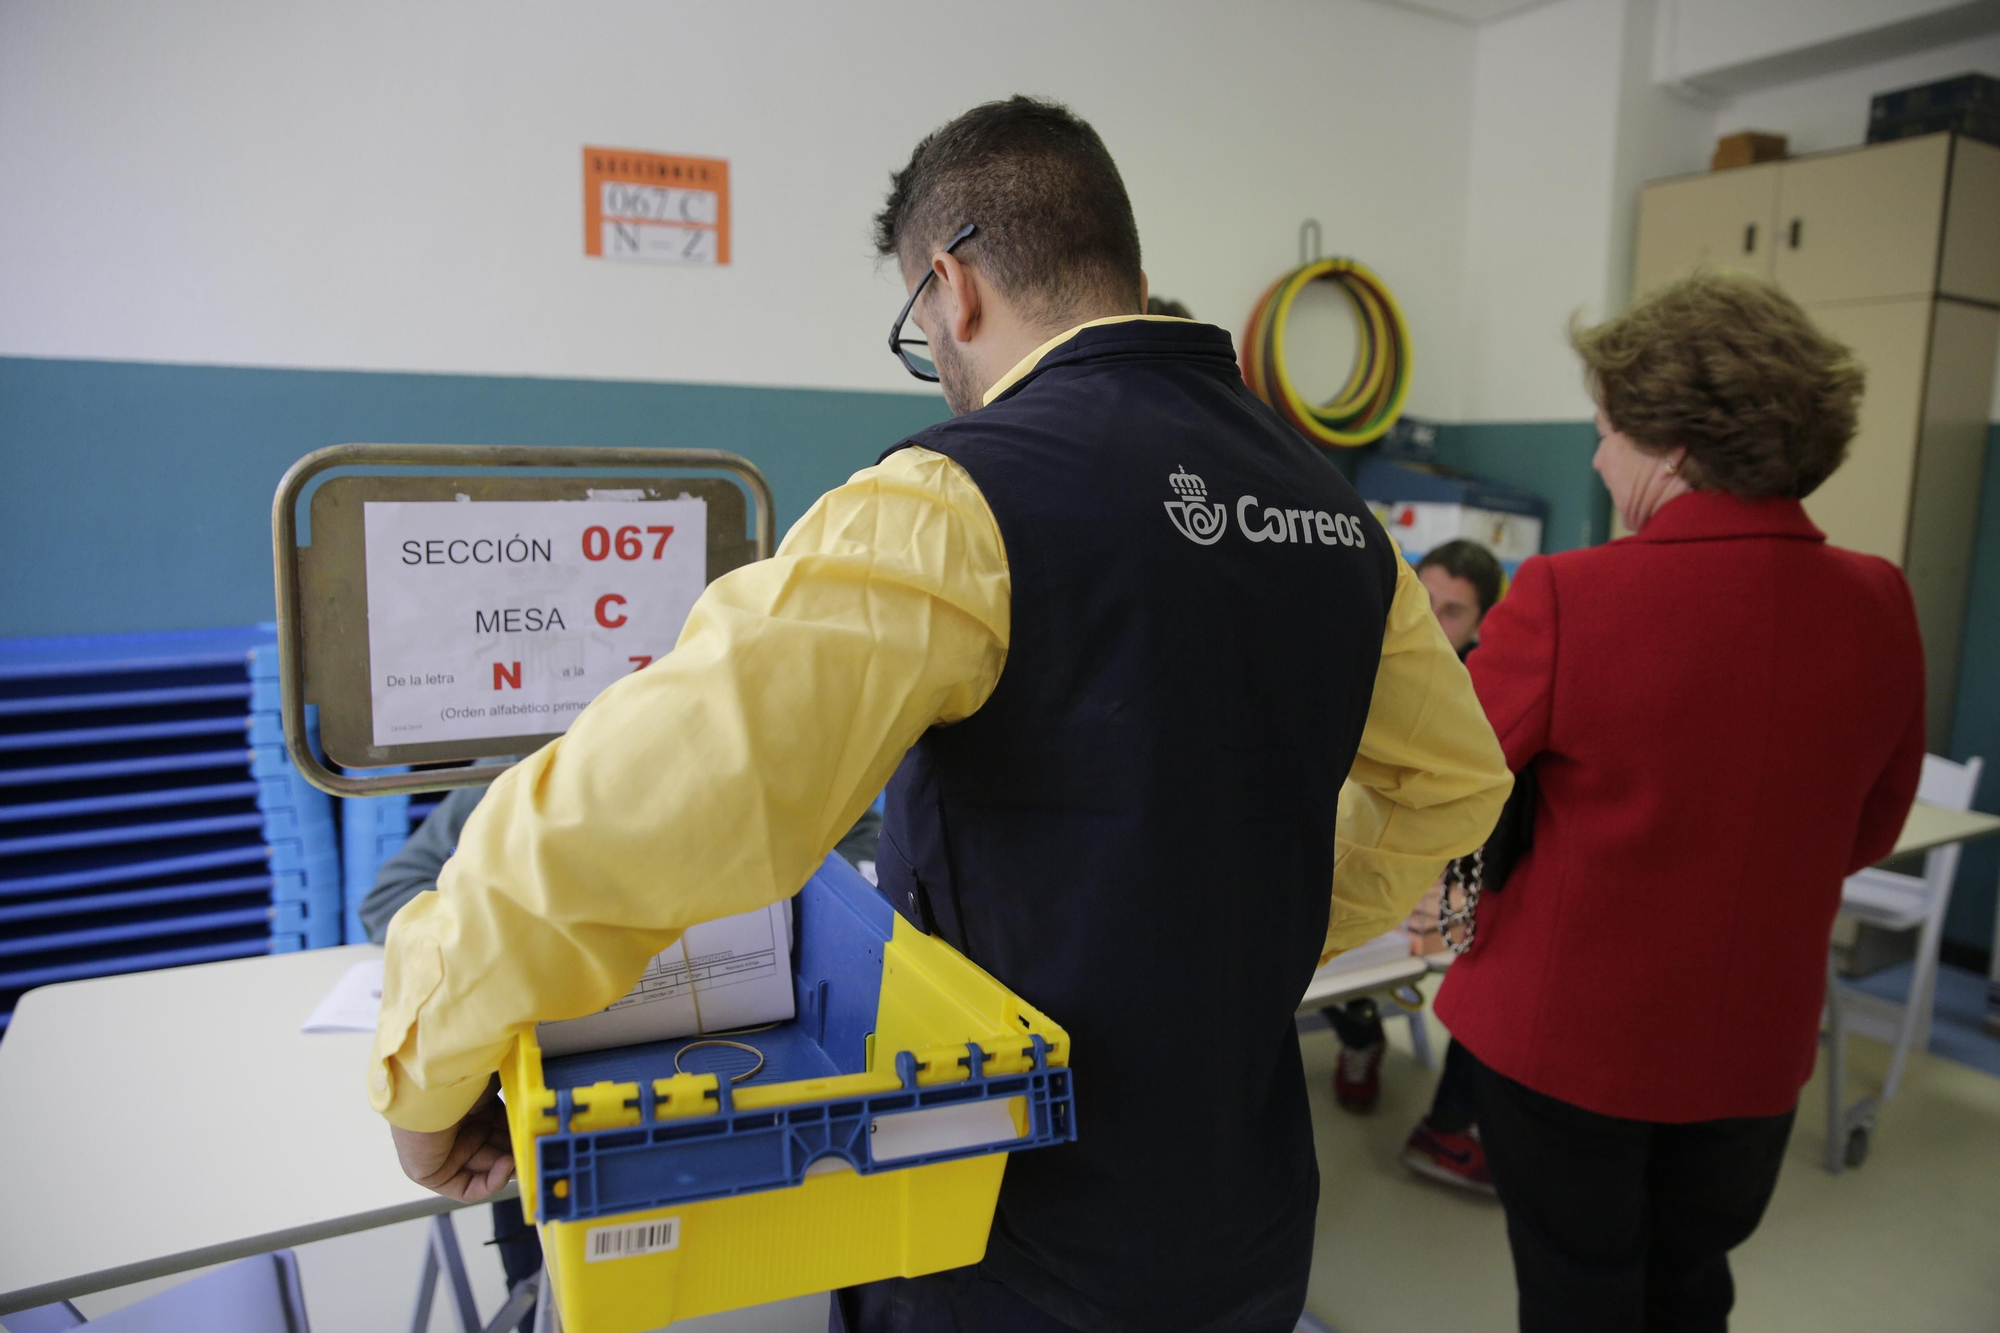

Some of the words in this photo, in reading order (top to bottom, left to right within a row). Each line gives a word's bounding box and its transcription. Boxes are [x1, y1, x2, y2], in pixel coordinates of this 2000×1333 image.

[608, 183, 669, 221] 067
[679, 191, 707, 224] C
[611, 222, 641, 252] N
[680, 227, 707, 262] Z
[1236, 495, 1366, 549] Correos
[402, 534, 551, 564] SECCIÓN
[582, 525, 674, 561] 067
[476, 608, 565, 633] MESA
[595, 593, 628, 628] C
[386, 674, 406, 687] De
[410, 673, 422, 686] la
[426, 672, 454, 685] letra
[493, 661, 522, 691] N
[562, 667, 571, 677] a
[573, 665, 585, 677] la
[440, 705, 486, 721] (Orden
[489, 700, 549, 717] alfabético
